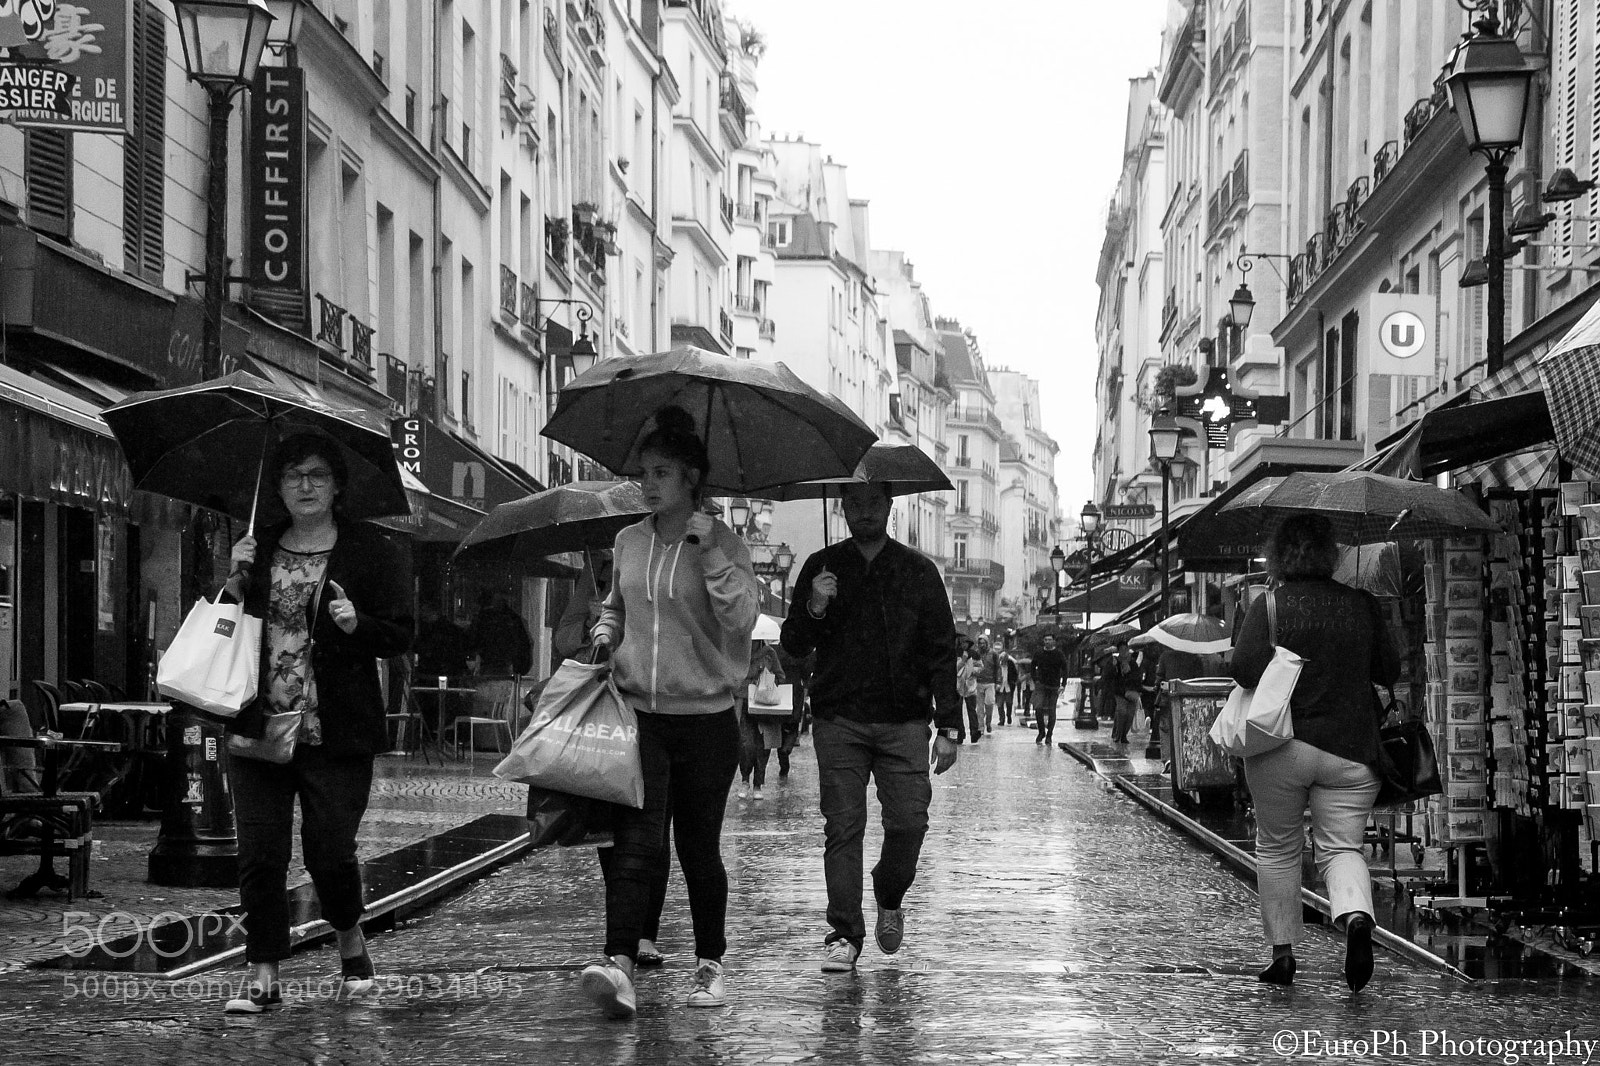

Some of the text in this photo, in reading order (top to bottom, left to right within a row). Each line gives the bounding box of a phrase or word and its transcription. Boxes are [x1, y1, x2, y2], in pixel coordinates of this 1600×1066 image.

[95, 77, 117, 99] DE
[1390, 324, 1415, 347] U
[403, 419, 421, 473] GROM
[1110, 507, 1150, 516] NICOLAS
[531, 711, 638, 742] PLLBEAR
